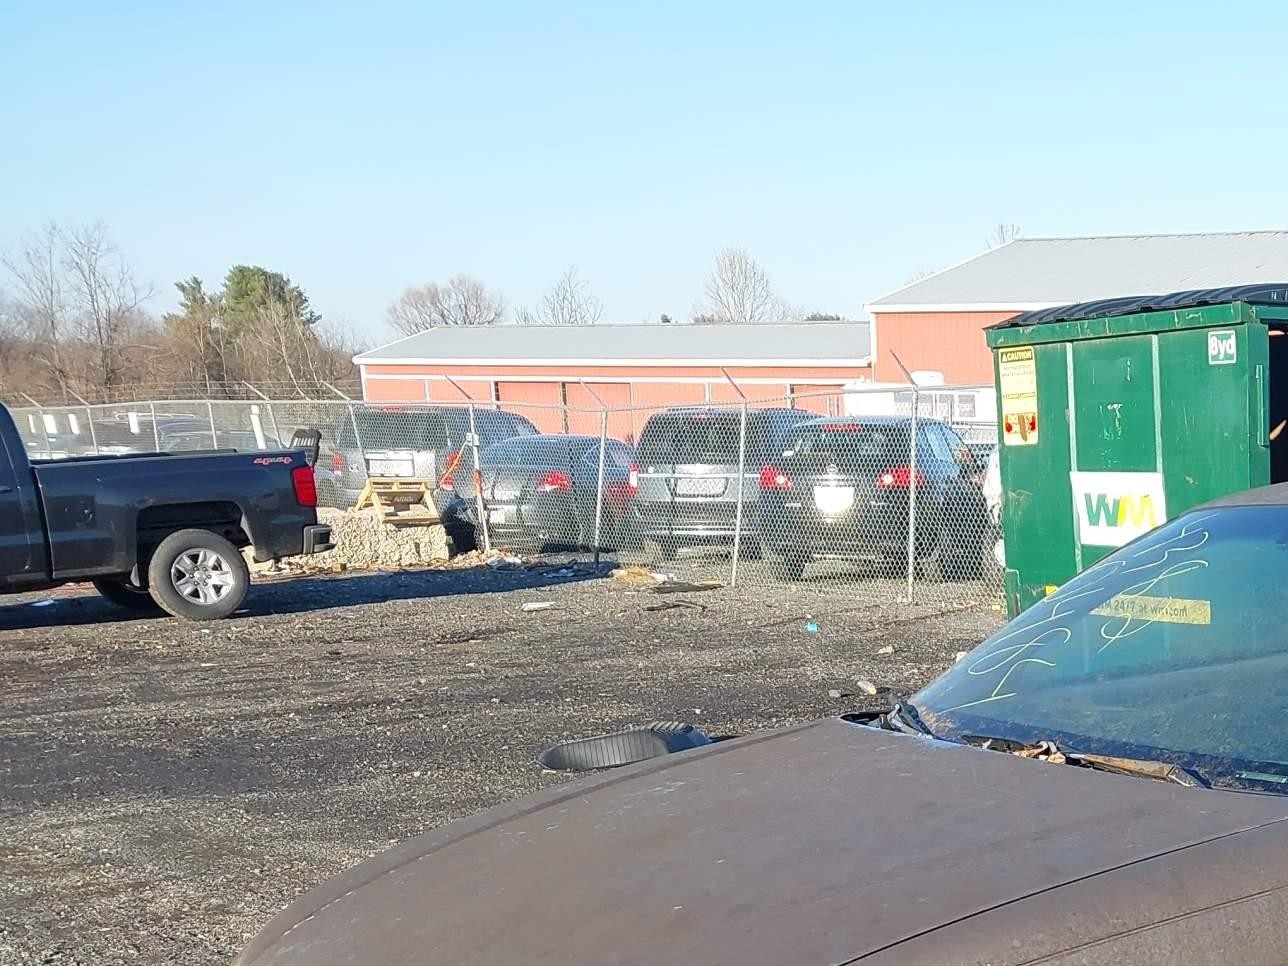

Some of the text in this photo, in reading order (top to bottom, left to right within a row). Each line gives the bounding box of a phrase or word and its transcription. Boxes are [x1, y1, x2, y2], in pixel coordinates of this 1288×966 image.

[1006, 351, 1032, 361] CAUTION
[1210, 334, 1236, 360] 8yd
[1083, 492, 1157, 529] WM
